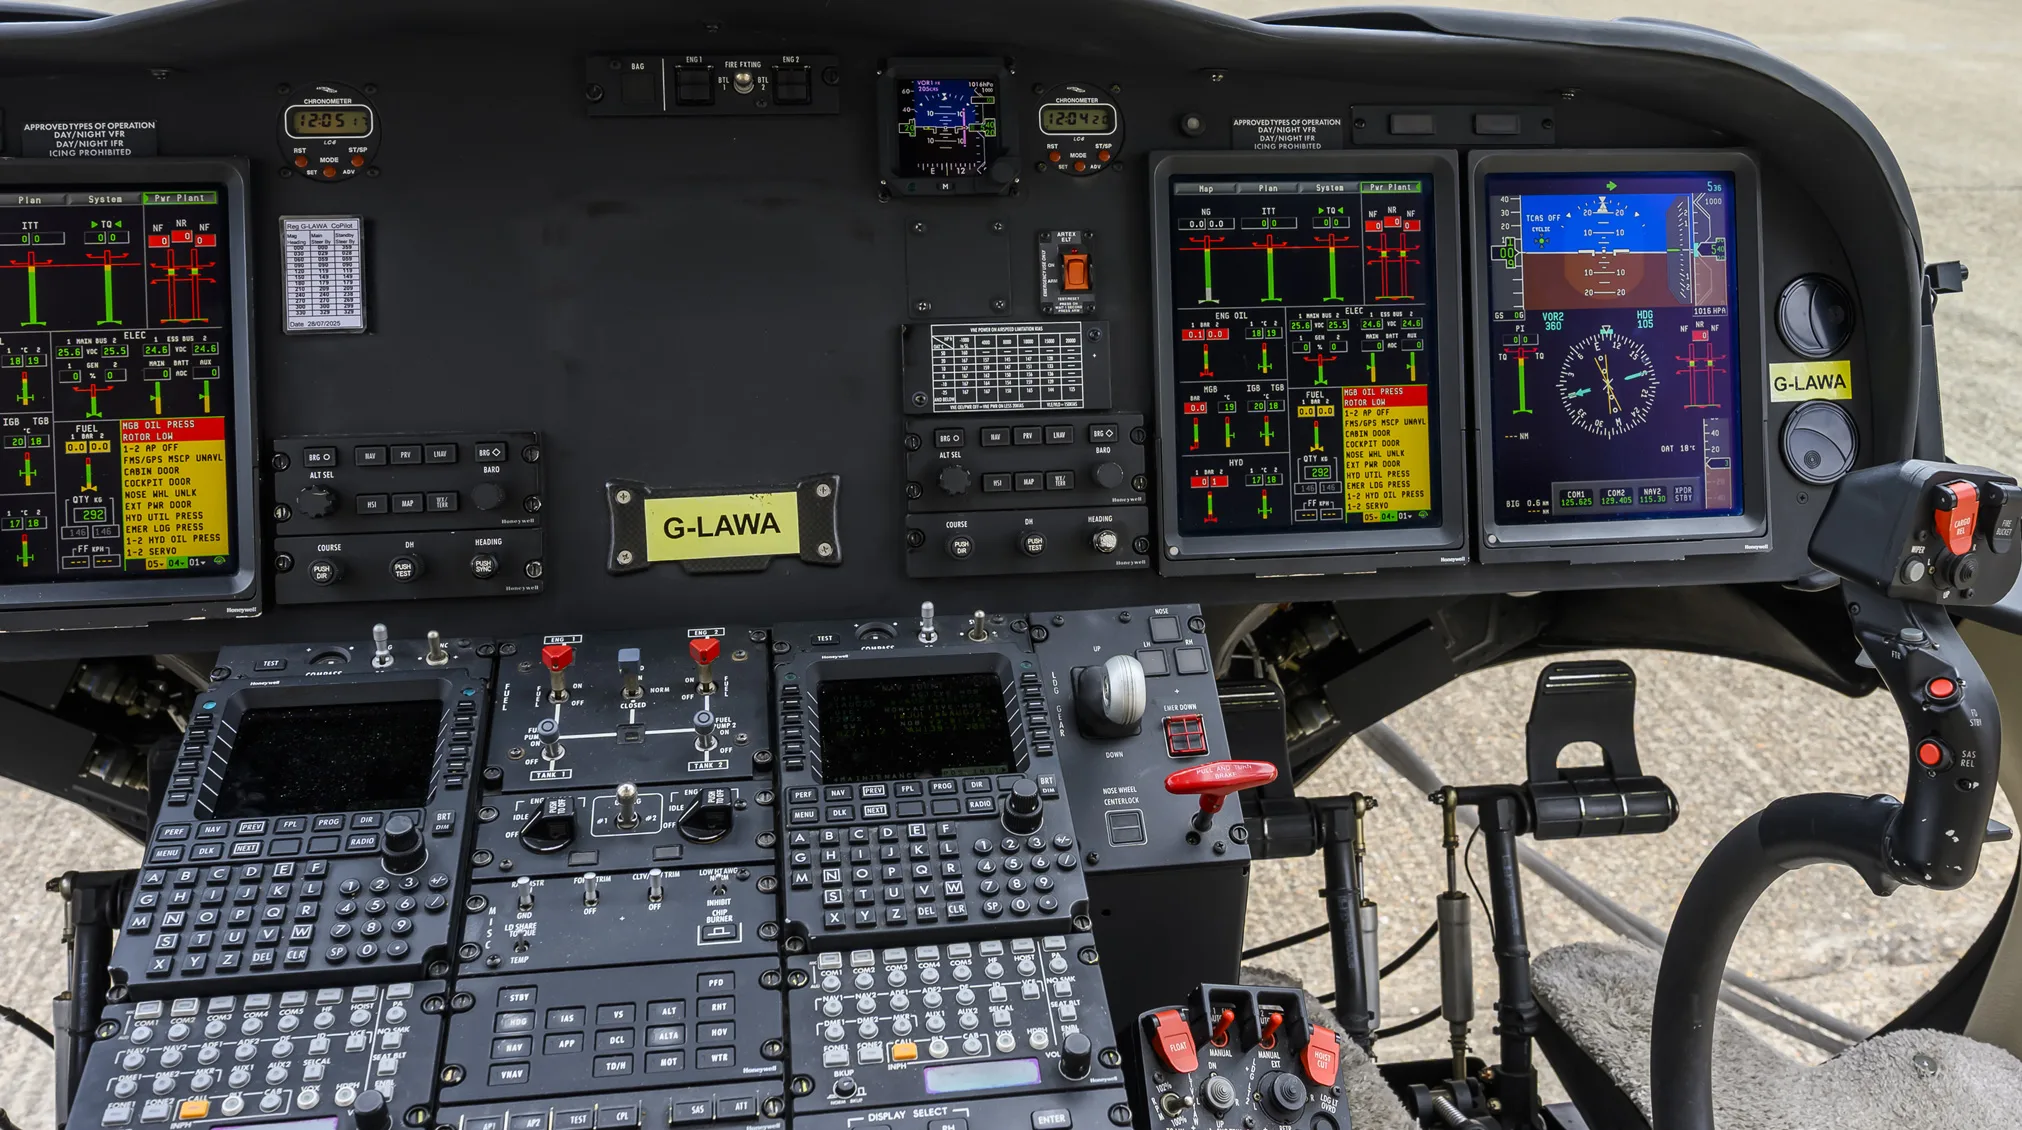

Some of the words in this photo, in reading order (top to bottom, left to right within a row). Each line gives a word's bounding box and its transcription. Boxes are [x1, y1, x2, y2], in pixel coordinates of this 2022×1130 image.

[300, 113, 345, 128] 12:05
[1048, 111, 1089, 126] 12:04
[1301, 118, 1341, 126] OPERATION
[94, 122, 106, 130] OF
[107, 121, 155, 130] OPERATION
[1258, 126, 1301, 134] DAY/NIGHT
[54, 130, 106, 140] DAY/NIGHT
[108, 130, 125, 138] VFR
[1259, 135, 1302, 143] DAY/NIGHT
[56, 140, 108, 149] DAY/NIGHT
[49, 149, 76, 157] ICING
[79, 148, 132, 156] PROHIBITED
[1198, 184, 1214, 195] Map
[1316, 184, 1344, 192] System
[18, 196, 42, 205] Plan
[88, 195, 123, 204] System
[154, 194, 170, 203] Pwr
[176, 193, 205, 202] Plant
[1201, 208, 1211, 216] NG
[1526, 214, 1544, 223] TCAS
[1547, 213, 1561, 222] OFF
[1636, 309, 1654, 320] HDG
[1693, 307, 1712, 315] 1016
[1713, 306, 1727, 315] HPA
[1542, 312, 1564, 322] VOR2
[1545, 321, 1562, 331] 360
[1637, 319, 1654, 329] 105
[1774, 373, 1847, 392] G-LAWA
[1380, 387, 1404, 395] PRESS
[122, 421, 139, 430] MGB
[144, 421, 161, 429] OIL
[167, 420, 195, 429] PRESS
[122, 433, 151, 441] ROTOR
[156, 432, 173, 440] LOW
[123, 445, 140, 453] 1-2
[145, 444, 157, 452] AP
[162, 443, 178, 452] OFF
[123, 455, 163, 464] FMS/GPS
[168, 454, 190, 463] MSCP
[195, 454, 223, 462] UNAVL
[124, 467, 152, 476] CABIN
[157, 466, 180, 475] DOOR
[483, 466, 500, 474] BARO
[124, 478, 163, 487] COCKPIT
[168, 477, 191, 486] DOOR
[124, 490, 147, 499] NOSE
[152, 489, 169, 498] WHL
[174, 489, 197, 497] UNLK
[1567, 490, 1585, 499] COM1
[1607, 489, 1625, 497] COM2
[1643, 488, 1661, 496] NAV2
[1561, 498, 1593, 507] 125.625
[1601, 496, 1633, 505] 129.405
[1640, 495, 1666, 503] 115.30
[1675, 494, 1693, 502] STBY
[125, 502, 142, 510] EXT
[147, 501, 164, 509] PWR
[169, 500, 192, 509] DOOR
[125, 513, 143, 522] HYD
[147, 513, 170, 521] UTIL
[175, 511, 204, 520] PRESS
[663, 512, 781, 540] G-LAWA
[1954, 517, 1971, 529] CARGO
[2002, 519, 2012, 527] FIRE
[126, 525, 148, 533] EMER
[176, 523, 204, 531] PRESS
[1956, 528, 1966, 536] REL
[1995, 528, 2013, 536] BUCKET
[126, 537, 143, 545] 1-2
[148, 536, 165, 544] HYD
[170, 535, 187, 543] OIL
[193, 534, 221, 542] PRESS
[475, 538, 503, 546] HEADING
[127, 548, 143, 557] 1-2
[149, 547, 177, 556] SERVO
[317, 543, 342, 552] COURSE
[313, 566, 330, 574] PUSH
[650, 686, 670, 694] NORM
[620, 702, 647, 710] CLOSED
[1105, 751, 1124, 759] DOWN
[1961, 749, 1976, 759] SAS
[694, 762, 713, 770] TANK
[1960, 758, 1975, 768] REL
[536, 771, 556, 779] TANK
[1102, 787, 1118, 795] NOSE
[1118, 786, 1137, 794] WHEEL
[969, 799, 992, 809] RADIO
[1104, 796, 1139, 806] CENTERLOCK
[283, 819, 298, 828] FPL
[318, 817, 340, 827] PROG
[164, 827, 185, 837] PERF
[350, 836, 375, 846] RADIO
[236, 843, 257, 853] NEXT
[156, 848, 179, 858] MENU
[706, 898, 732, 907] INHIBIT
[516, 912, 533, 920] GND
[706, 915, 733, 924] BURNER
[510, 955, 530, 964] TEMP
[708, 978, 724, 987] PFD
[509, 993, 530, 1002] STBY
[659, 1031, 679, 1040] ALTA
[1169, 1042, 1188, 1052] FLOAT
[711, 1053, 728, 1062] WTR
[1209, 1049, 1233, 1058] MANUAL
[1258, 1051, 1281, 1060] MANUAL
[1314, 1052, 1331, 1062] HOIST
[1317, 1060, 1329, 1069] CUT
[501, 1069, 523, 1079] VNAV
[868, 1111, 906, 1122] DISPLAY
[913, 1107, 948, 1118] SELECT
[1038, 1113, 1066, 1125] ENTER
